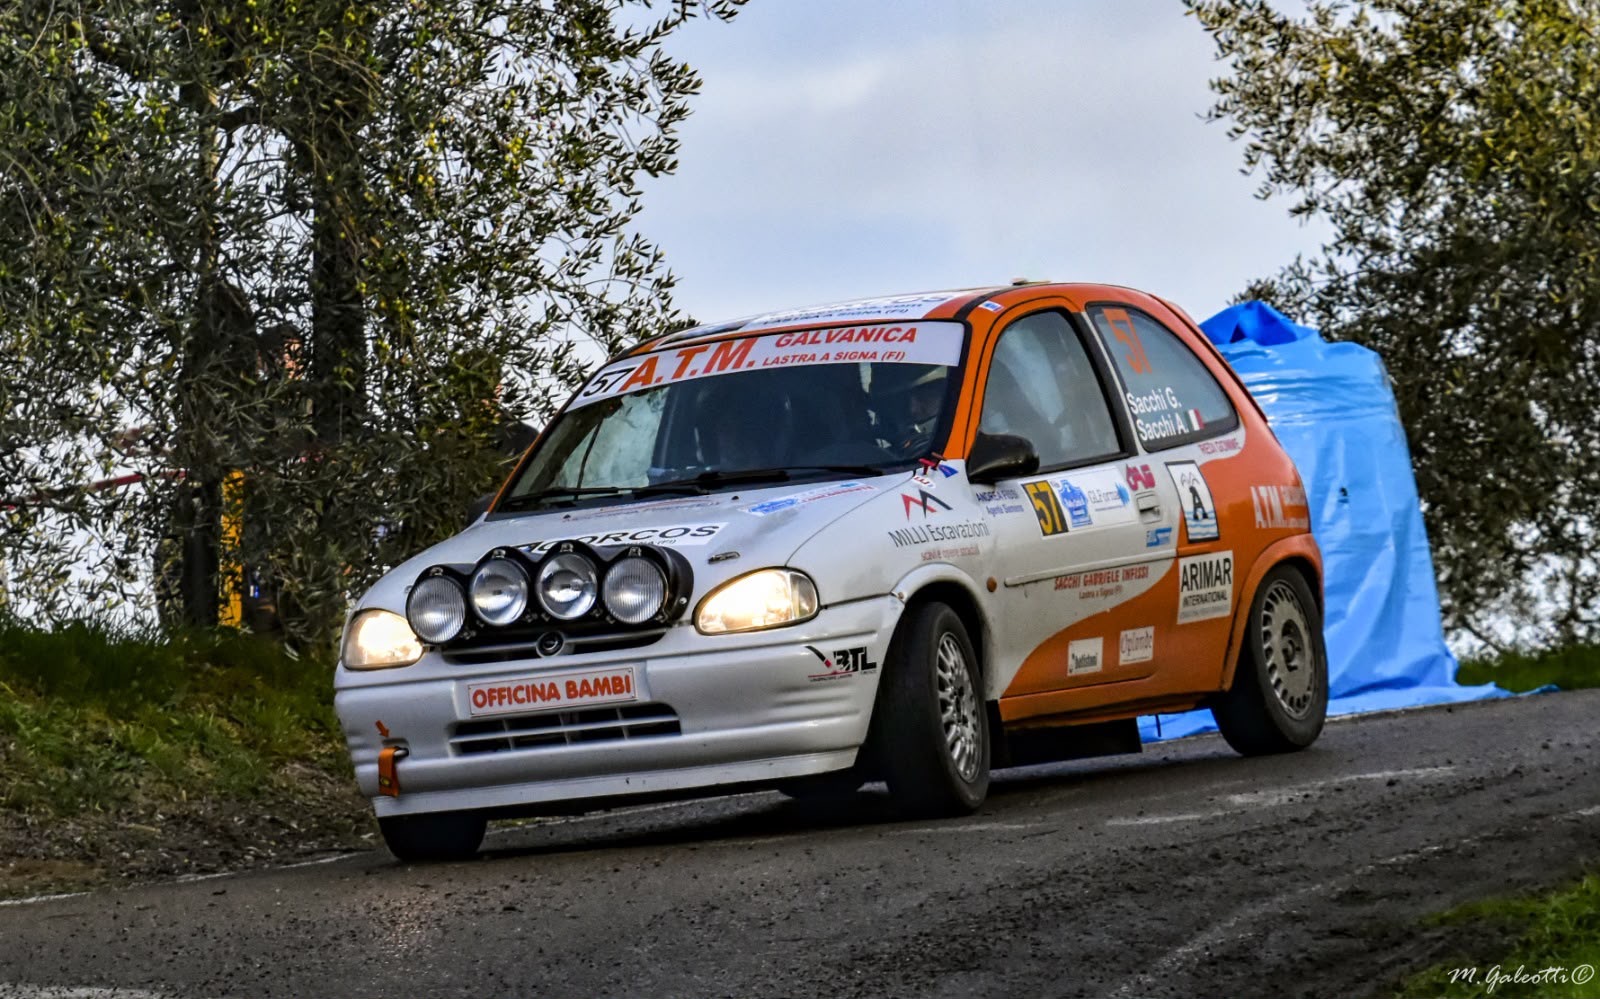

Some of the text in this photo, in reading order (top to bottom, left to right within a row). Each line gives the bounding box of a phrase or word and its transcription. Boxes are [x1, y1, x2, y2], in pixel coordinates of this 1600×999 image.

[775, 327, 917, 348] GALVANICA
[1103, 308, 1152, 374] 57
[617, 337, 759, 393] A.T.M.
[762, 350, 906, 367] LASTRA A SIGNA (FI)
[583, 366, 637, 397] 57
[1126, 387, 1182, 415] Sacchi G.
[1136, 412, 1190, 441] Sacchi A.
[1025, 480, 1063, 535] 57
[887, 518, 991, 548] MILLI Escavazioni
[1054, 565, 1149, 592] SACCHI GABRIELE INFISSI
[1181, 557, 1232, 593] ARIMAR
[1183, 590, 1228, 608] INTERNATIONAL
[472, 675, 631, 709] OFFICINA BAMBI
